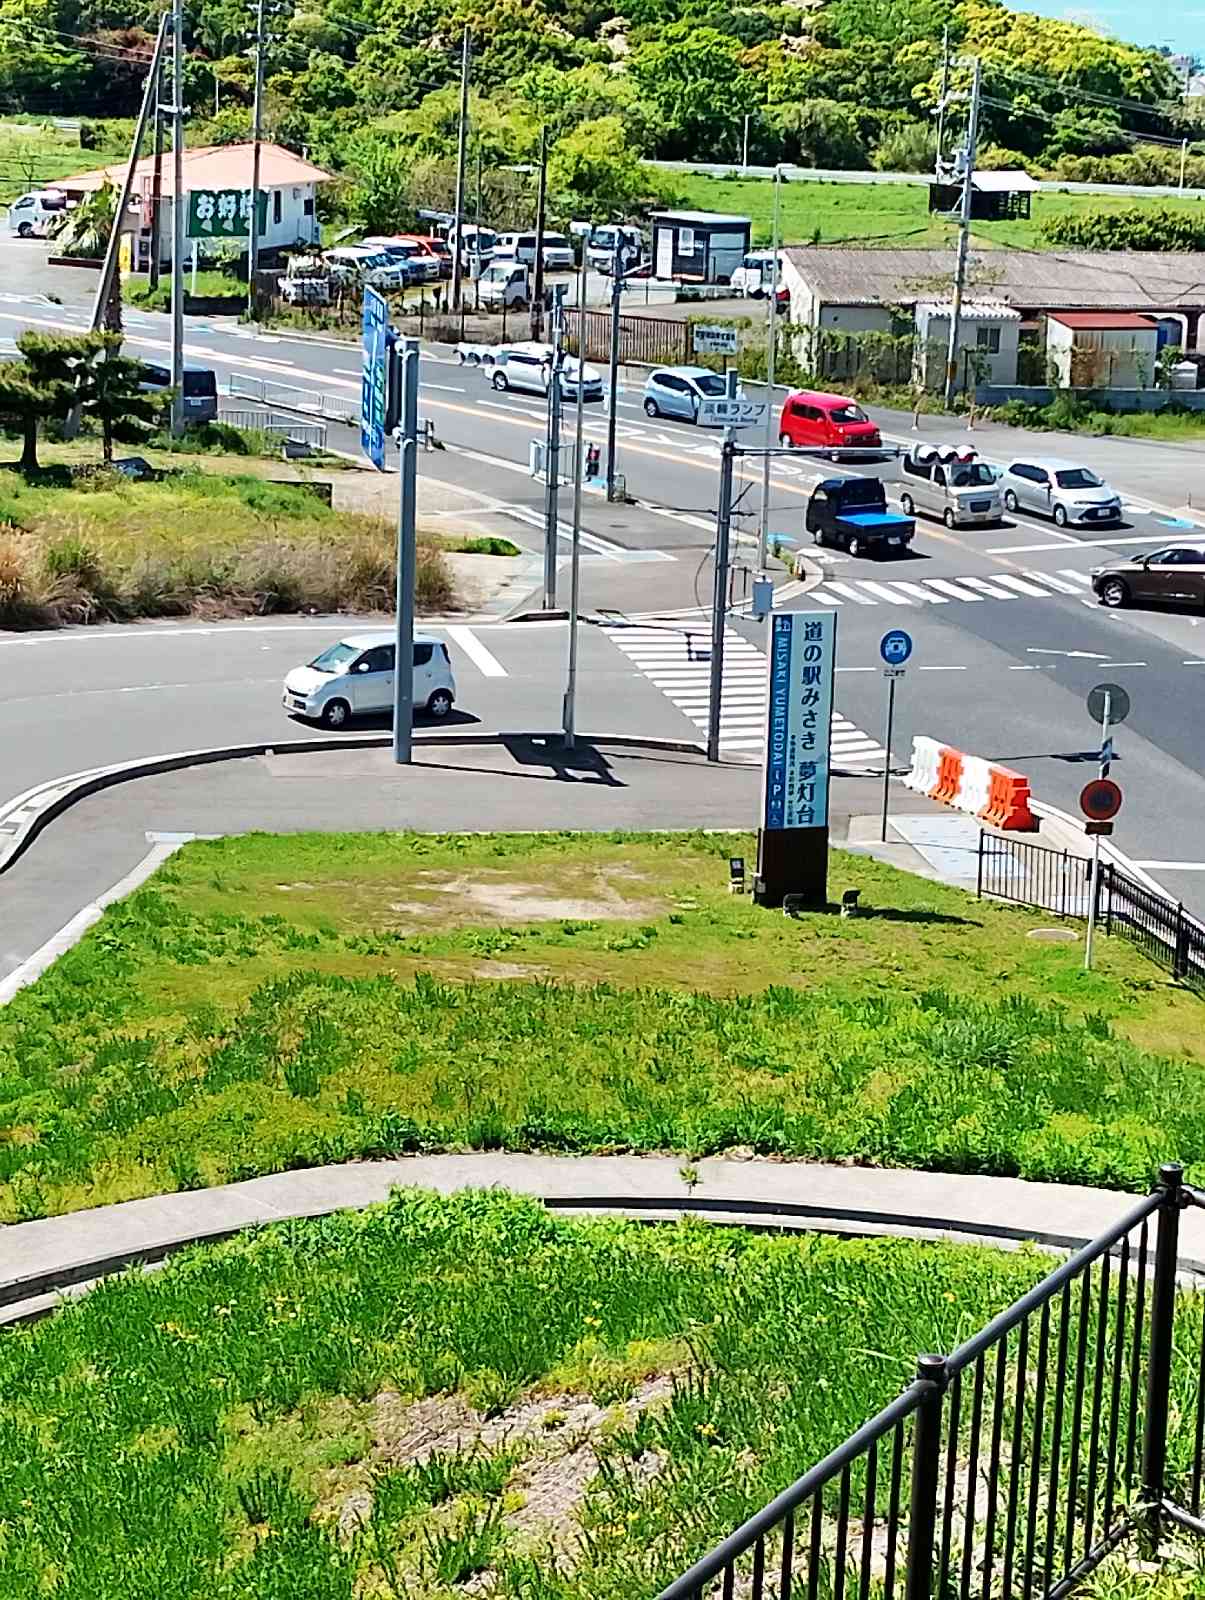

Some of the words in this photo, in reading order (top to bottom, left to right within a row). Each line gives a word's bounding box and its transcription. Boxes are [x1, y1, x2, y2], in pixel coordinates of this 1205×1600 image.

[775, 637, 788, 682] MISAKI
[801, 622, 823, 750] 道の駅みさき
[773, 688, 787, 765] YUMETODAI
[796, 761, 817, 824] 夢灯台
